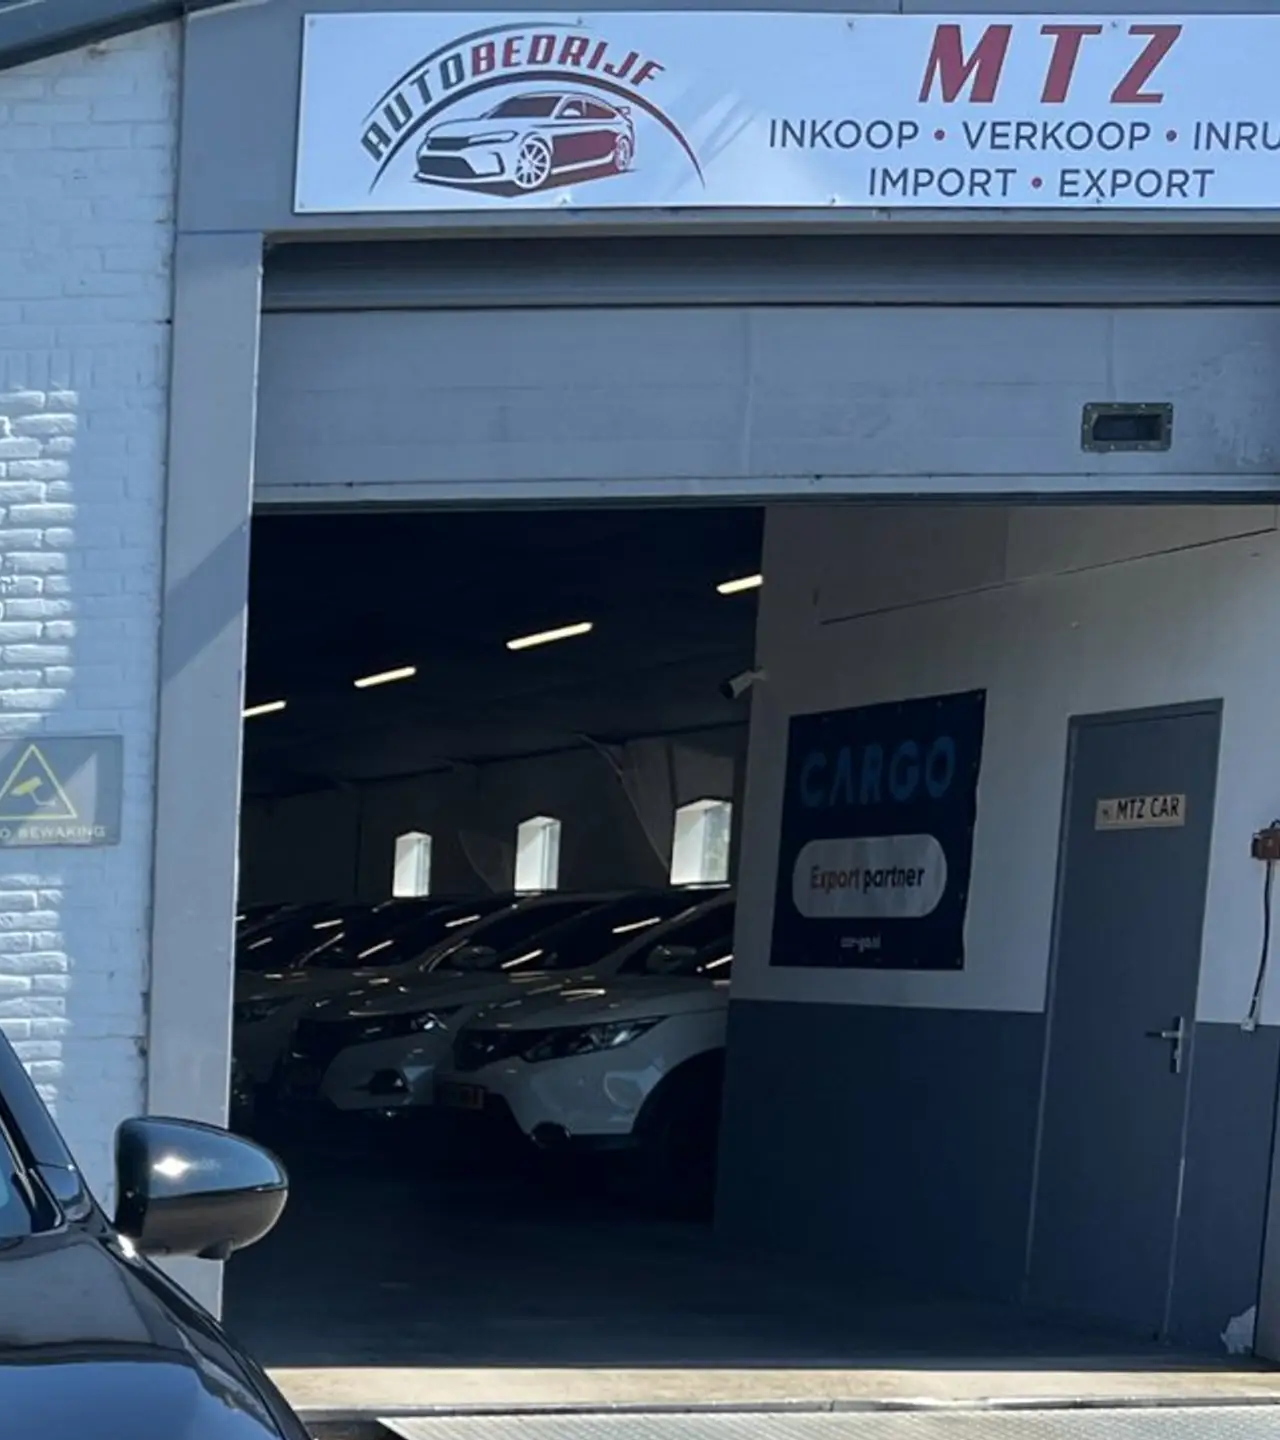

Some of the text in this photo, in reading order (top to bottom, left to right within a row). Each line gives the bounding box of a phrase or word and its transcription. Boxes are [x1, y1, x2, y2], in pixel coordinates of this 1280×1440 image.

[918, 24, 1184, 104] MTZ
[360, 33, 667, 163] AUTOBEDRIJF
[769, 119, 1280, 151] INKOOP VERKOOP INRU
[869, 168, 1215, 199] IMPORT EXPORT
[800, 735, 955, 808] CARGO
[1117, 796, 1180, 820] MTZ CAR
[811, 865, 926, 894] Export partner
